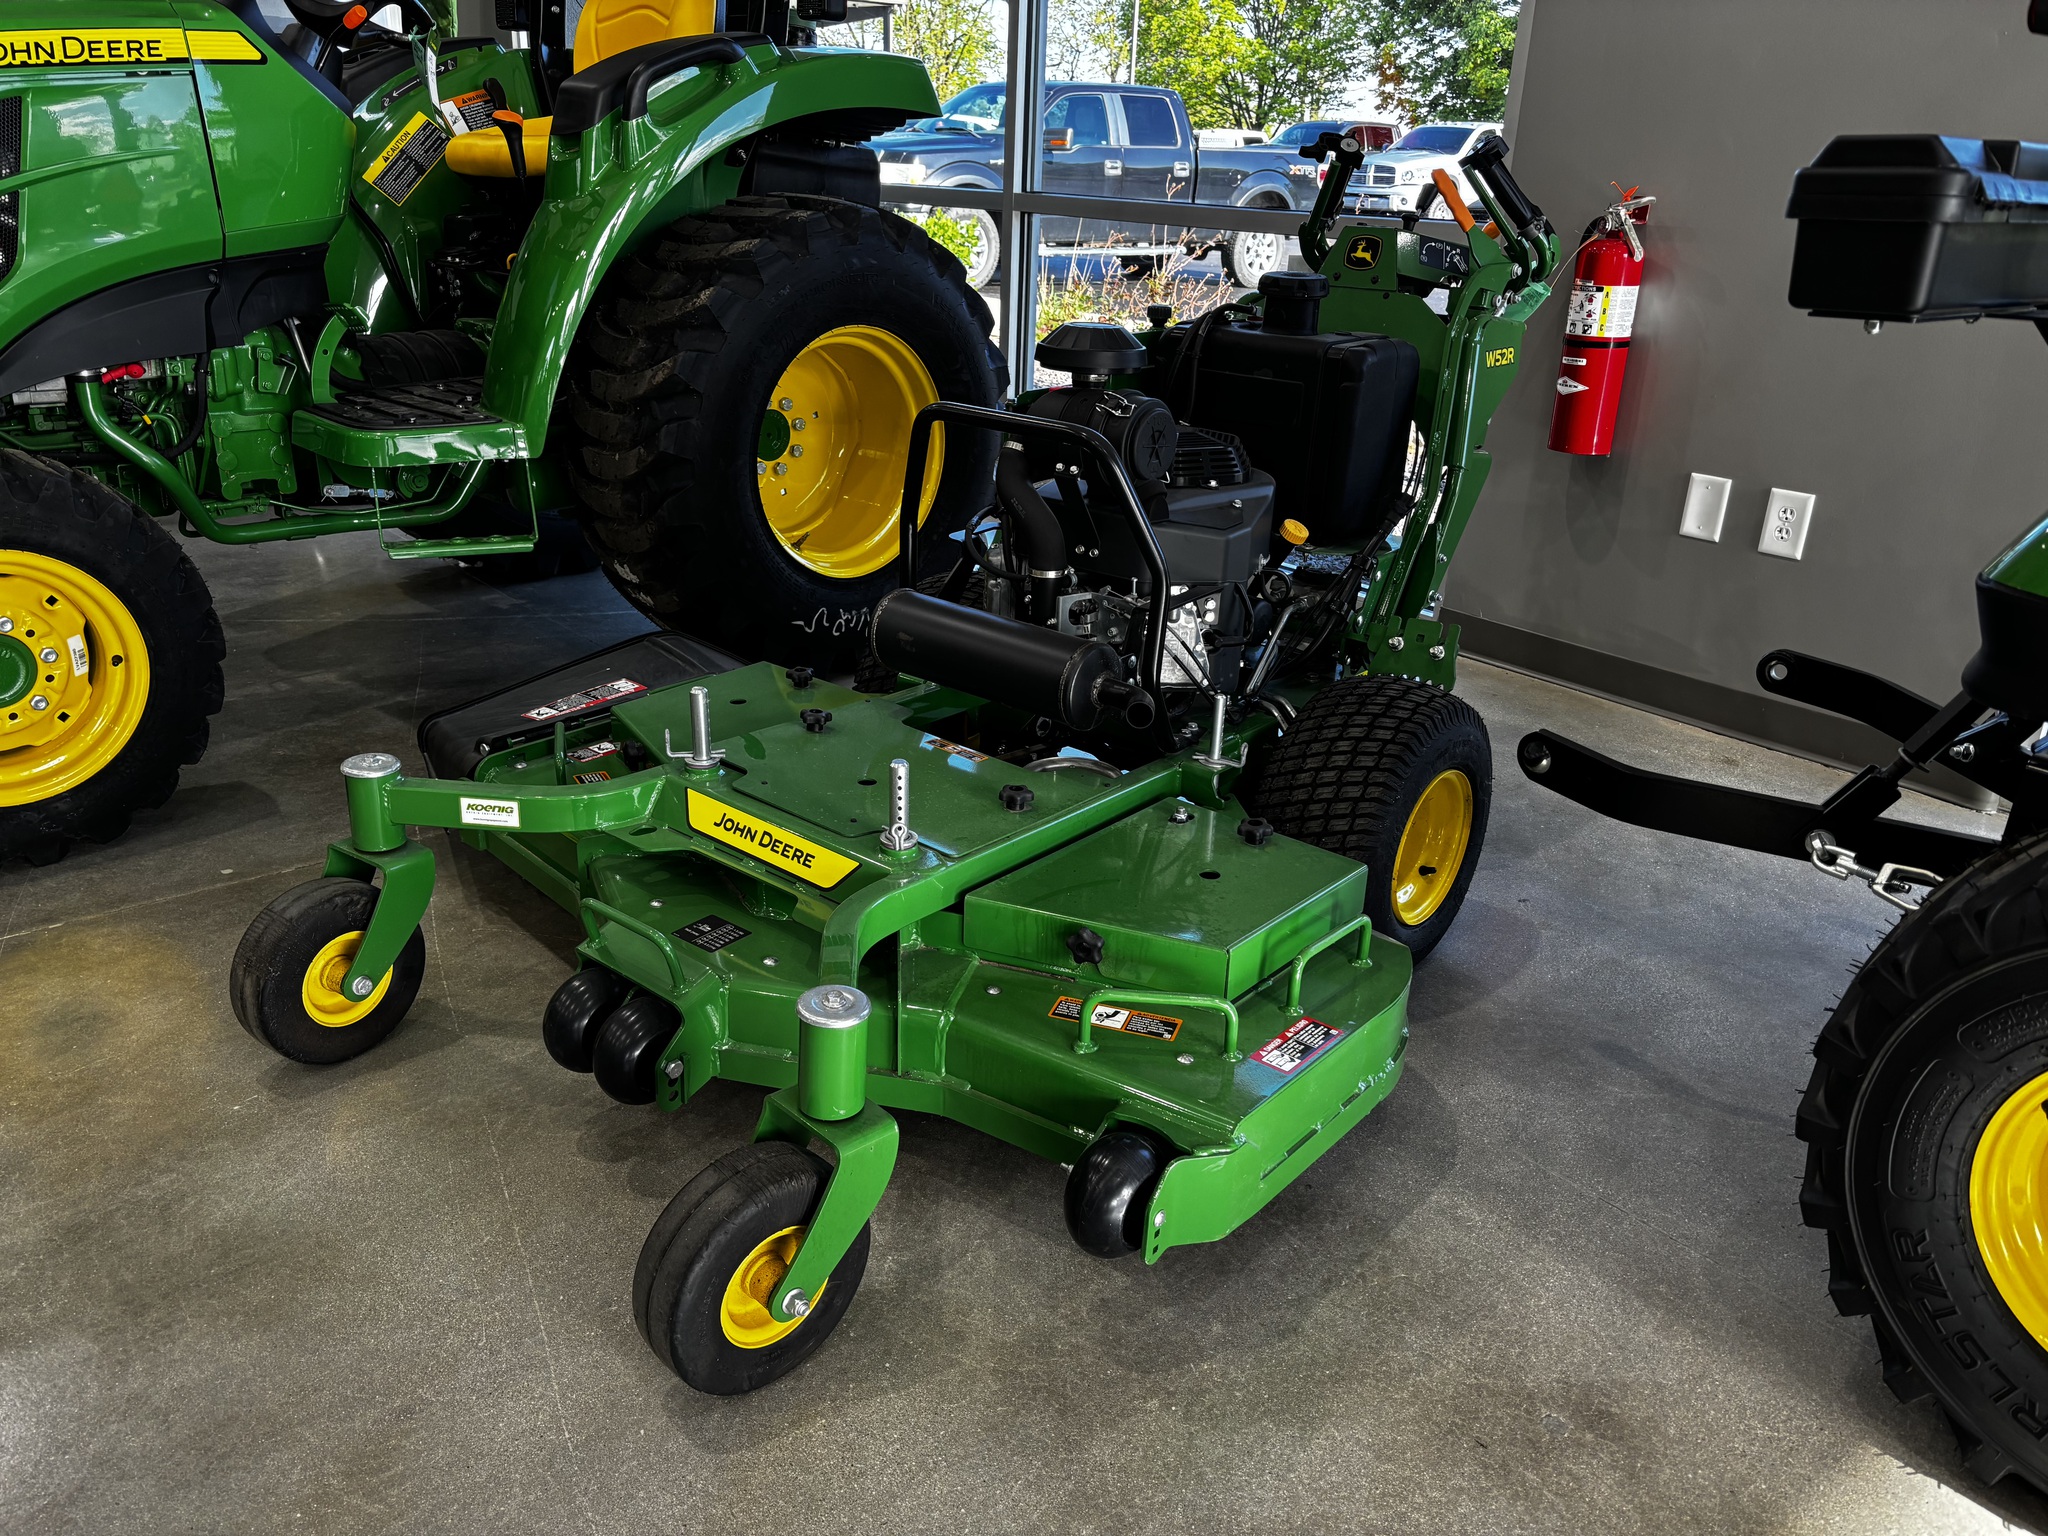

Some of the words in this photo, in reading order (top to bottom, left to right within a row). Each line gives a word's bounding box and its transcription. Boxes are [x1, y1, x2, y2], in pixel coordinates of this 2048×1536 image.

[61, 36, 163, 59] DEERE
[386, 130, 412, 158] CAUTION
[1485, 346, 1515, 368] W52R
[713, 812, 758, 843] JOHN
[757, 830, 816, 869] DEERE
